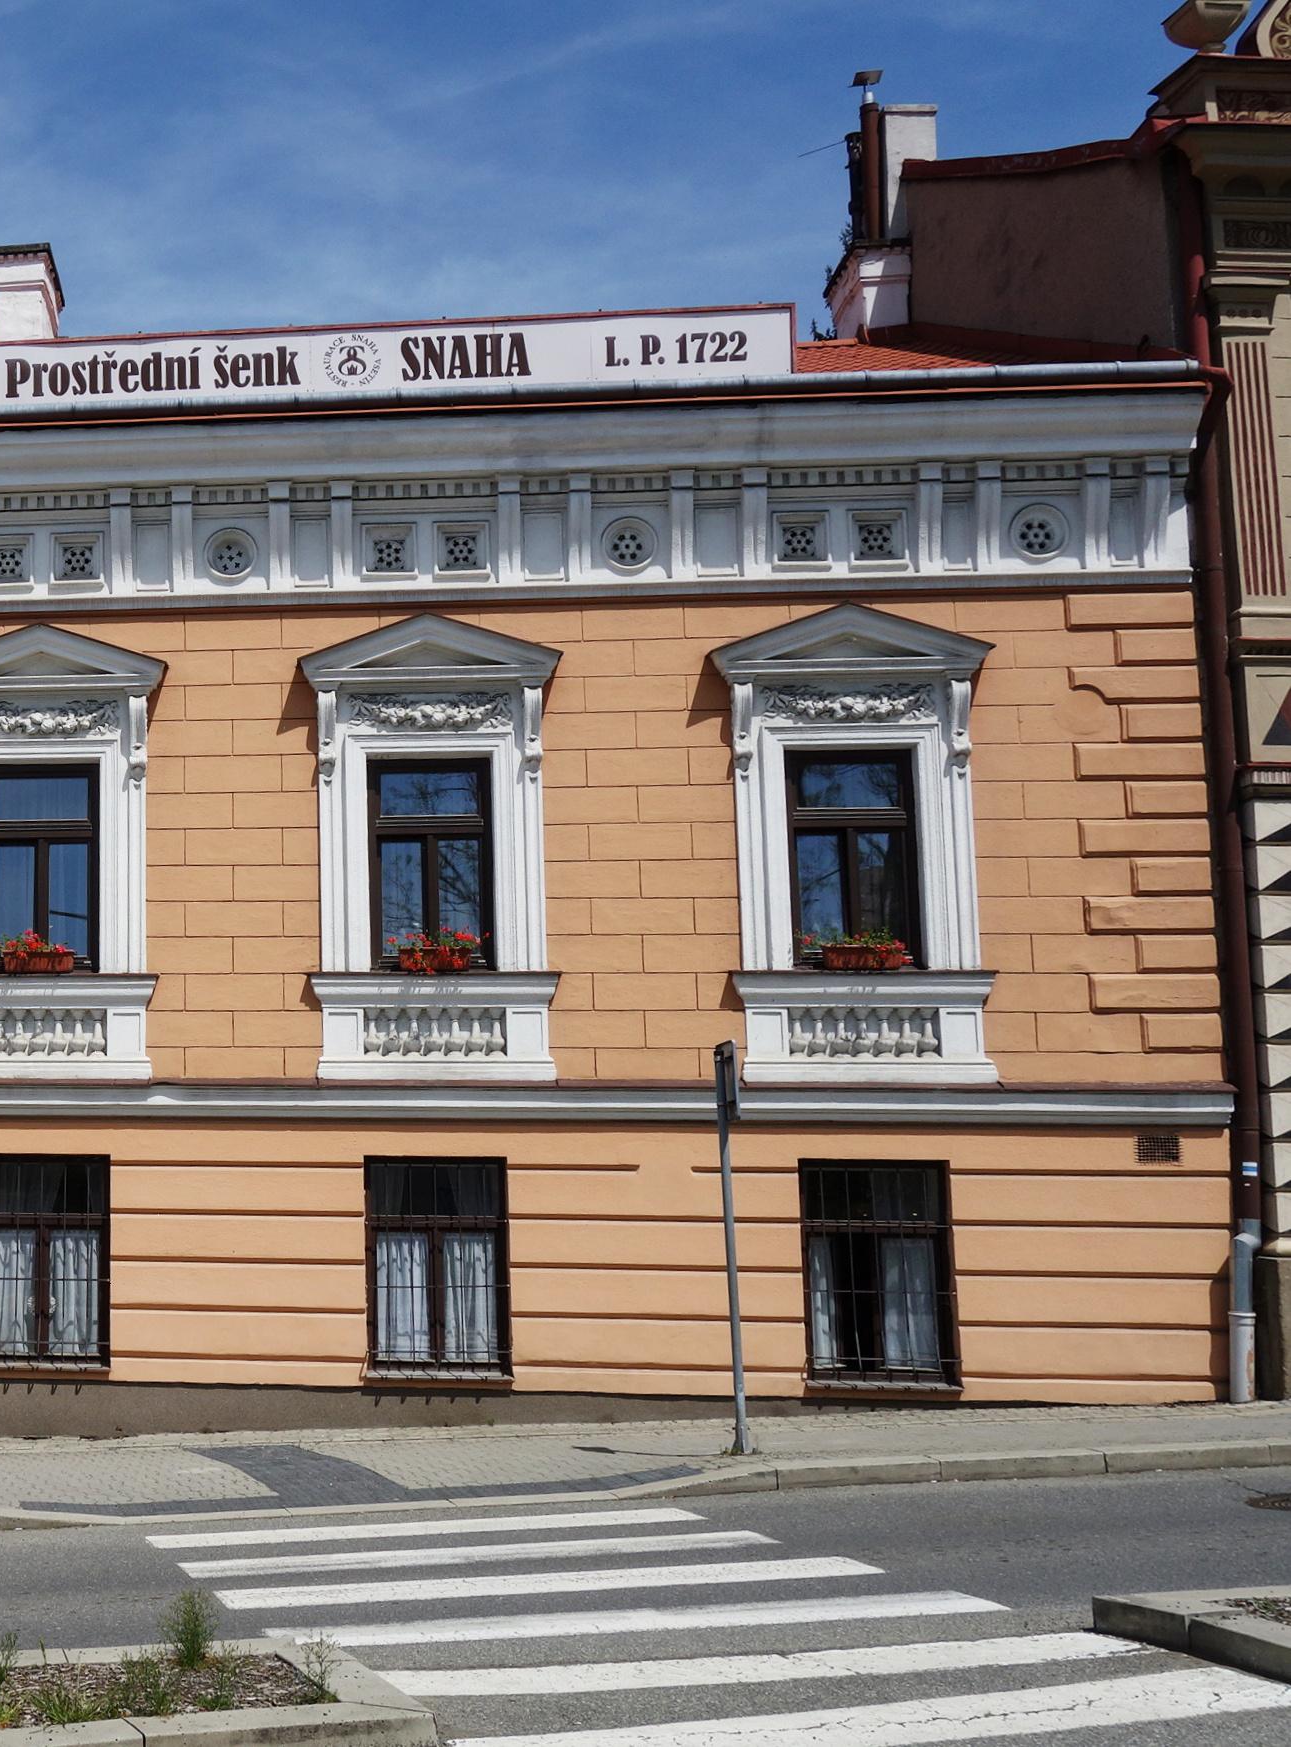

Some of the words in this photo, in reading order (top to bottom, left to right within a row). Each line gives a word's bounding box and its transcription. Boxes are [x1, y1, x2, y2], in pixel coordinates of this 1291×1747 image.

[5, 346, 201, 398] Prostřední
[214, 345, 301, 389] šenk
[401, 332, 532, 381] SNAHA
[605, 336, 630, 367] L.
[640, 334, 666, 365] P.
[675, 331, 748, 363] 1722
[323, 336, 348, 388] RESTAURACE
[351, 334, 379, 355] SNAHA
